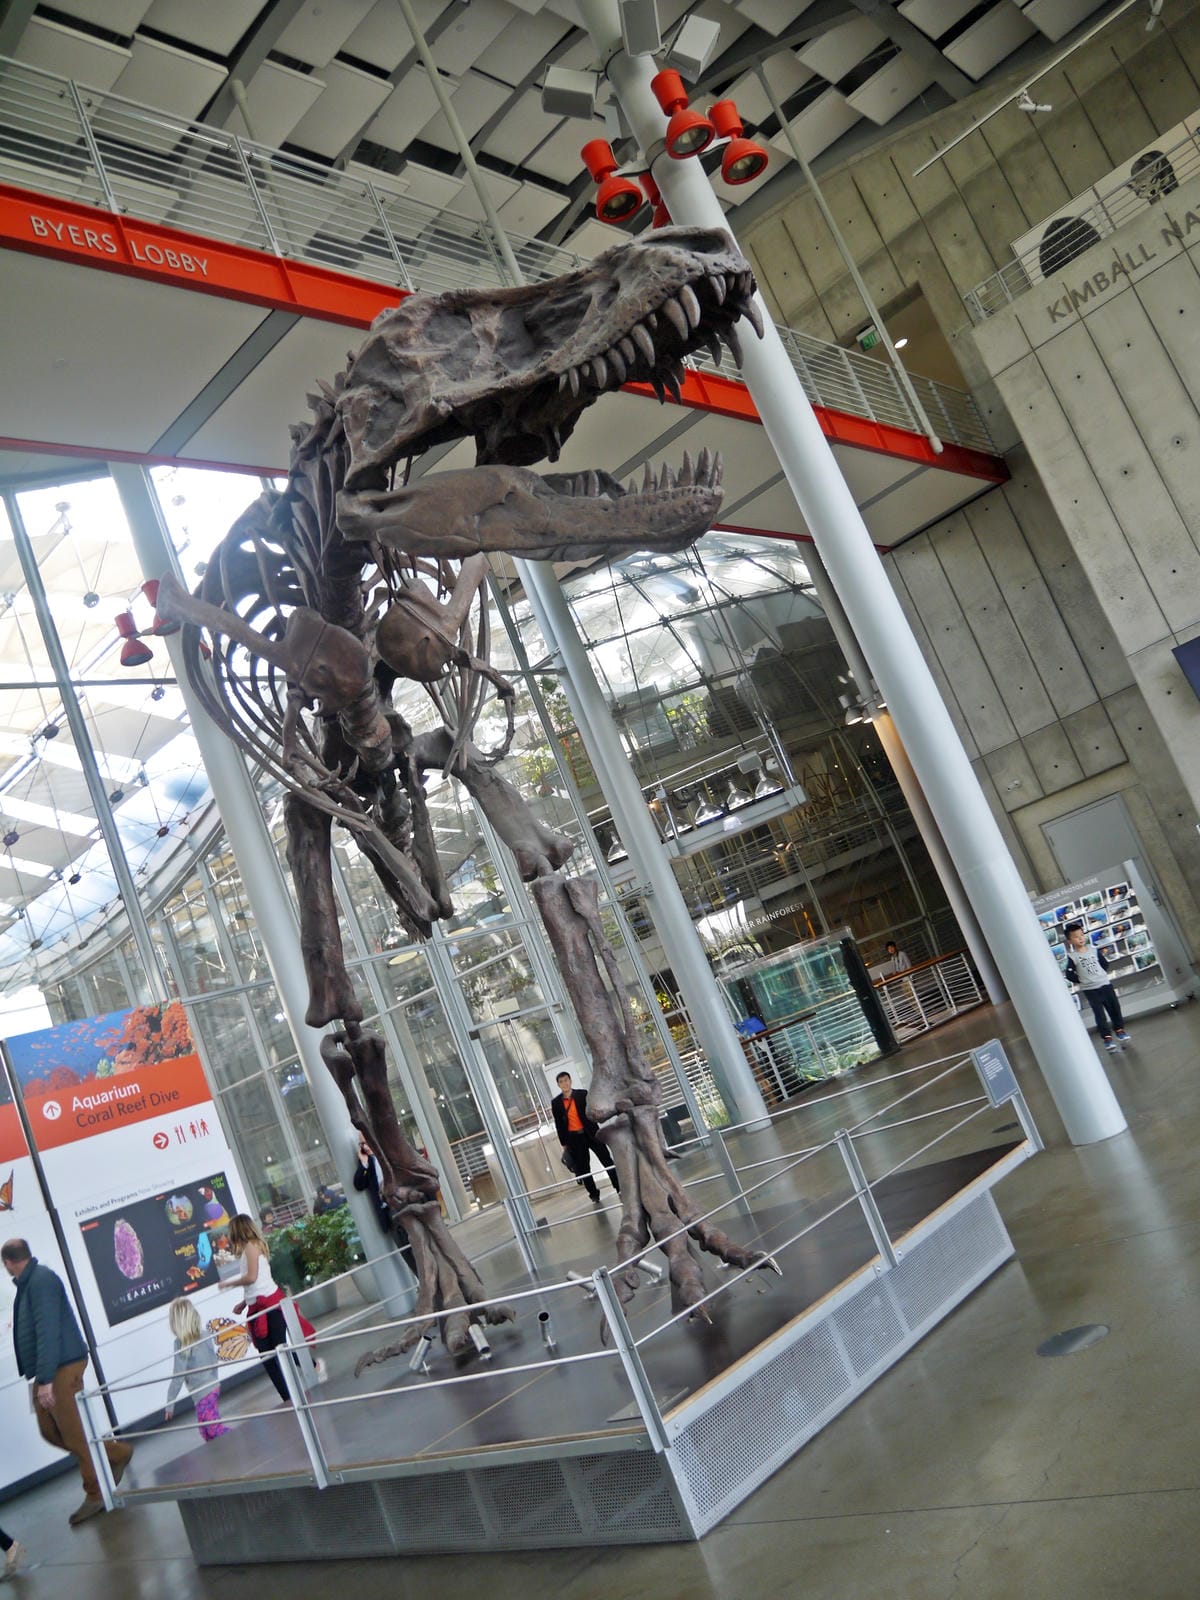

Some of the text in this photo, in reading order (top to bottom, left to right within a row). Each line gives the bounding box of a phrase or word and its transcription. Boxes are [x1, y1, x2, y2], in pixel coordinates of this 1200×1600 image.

[29, 215, 209, 276] BYERS LOBBY
[1045, 204, 1200, 324] KIMBALL NA
[756, 902, 805, 926] RAINFOREST
[72, 1082, 141, 1112] Aquarium
[75, 1089, 180, 1128] Coral Reef Dive
[74, 1205, 99, 1218] Exhibits
[110, 1190, 138, 1205] Programs
